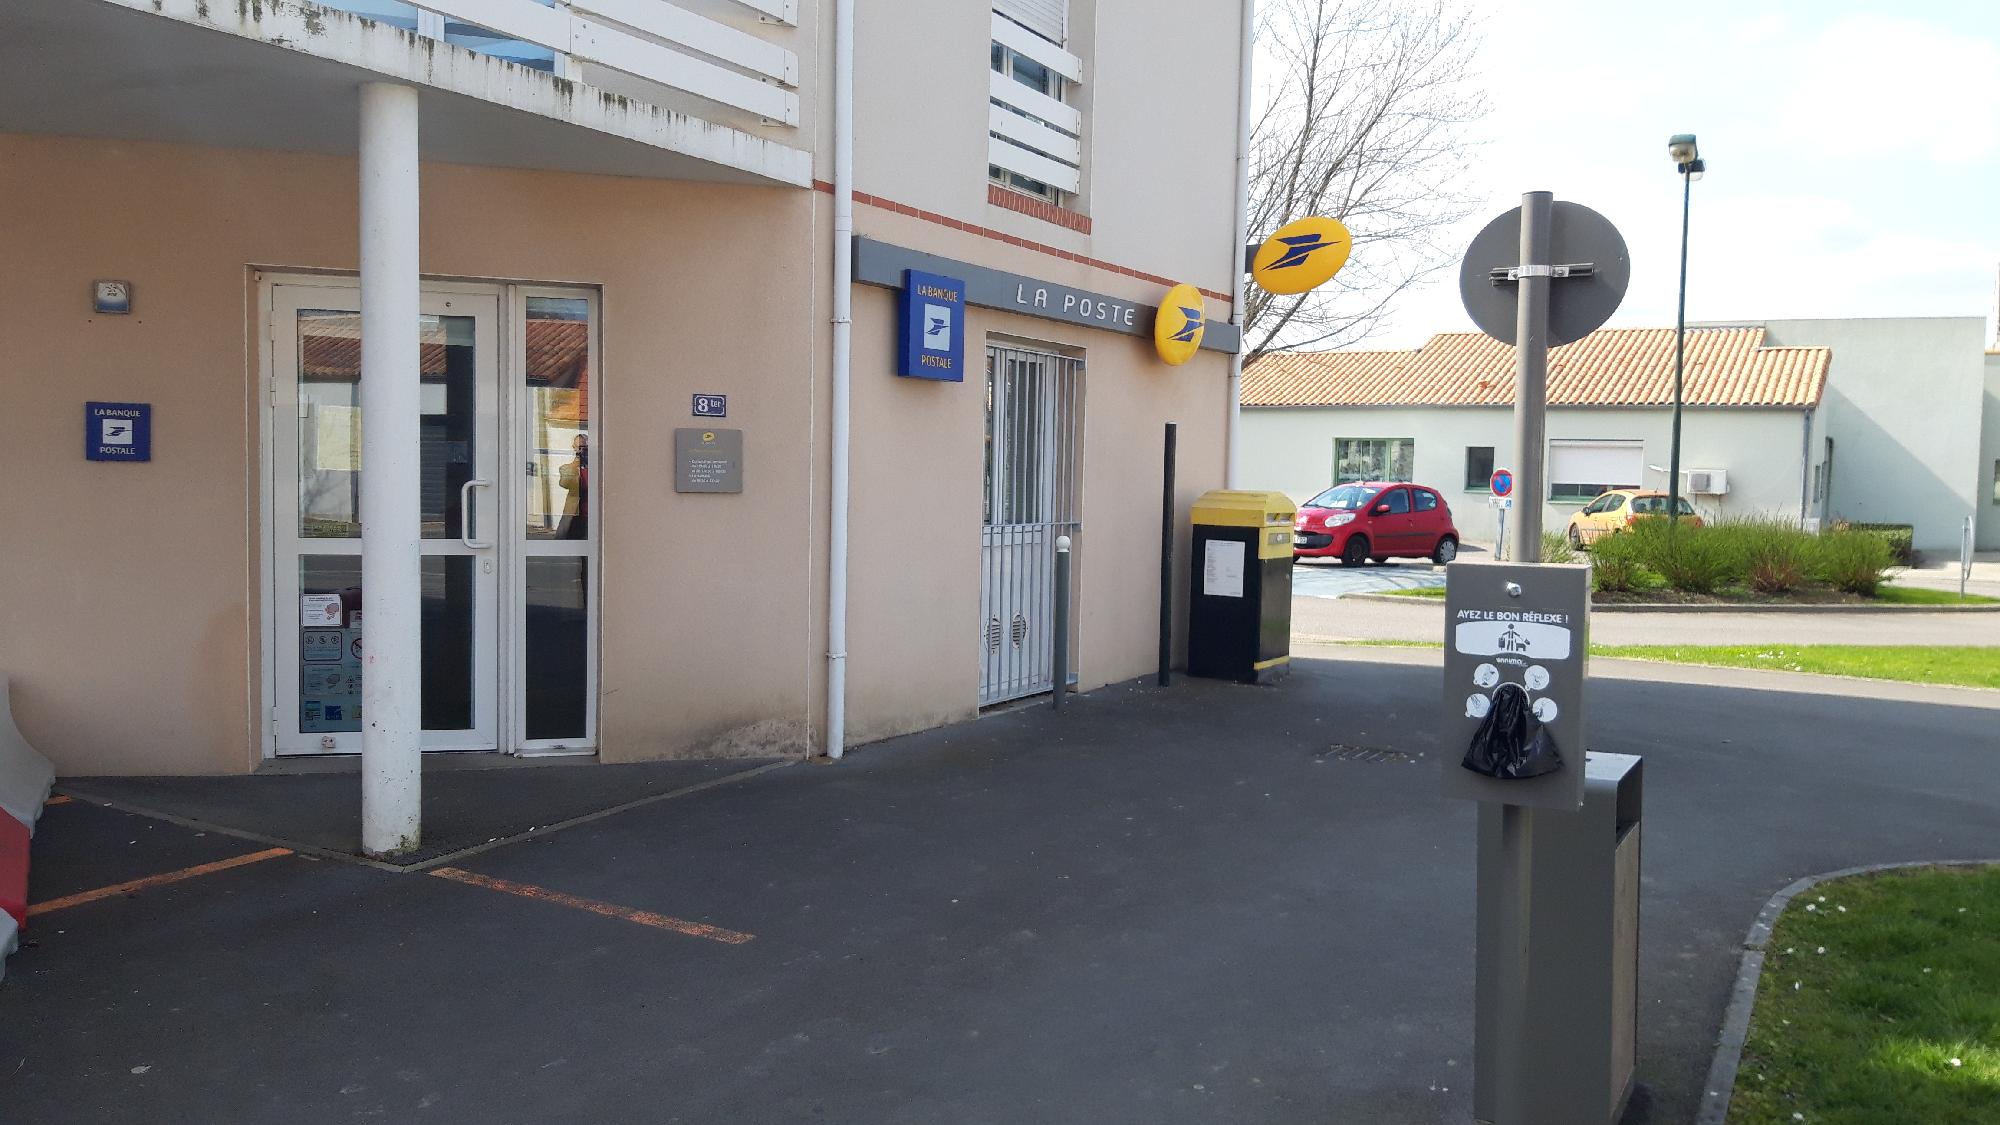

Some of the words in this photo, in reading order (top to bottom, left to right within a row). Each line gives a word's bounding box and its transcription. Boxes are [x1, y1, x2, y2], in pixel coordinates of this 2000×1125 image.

[917, 284, 927, 296] LA
[927, 286, 958, 302] BANQUE
[1016, 283, 1047, 308] LA
[1063, 294, 1135, 326] POSTE
[921, 355, 952, 369] POSTALE
[698, 398, 709, 412] 8
[711, 399, 722, 408] ter
[94, 408, 105, 416] LA
[106, 409, 141, 418] BANQUE
[100, 446, 136, 455] POSTALE
[1457, 609, 1481, 619] AYEZ
[1484, 611, 1495, 620] LE
[1496, 611, 1520, 621] BON
[1522, 611, 1562, 623] RÉFLEXE
